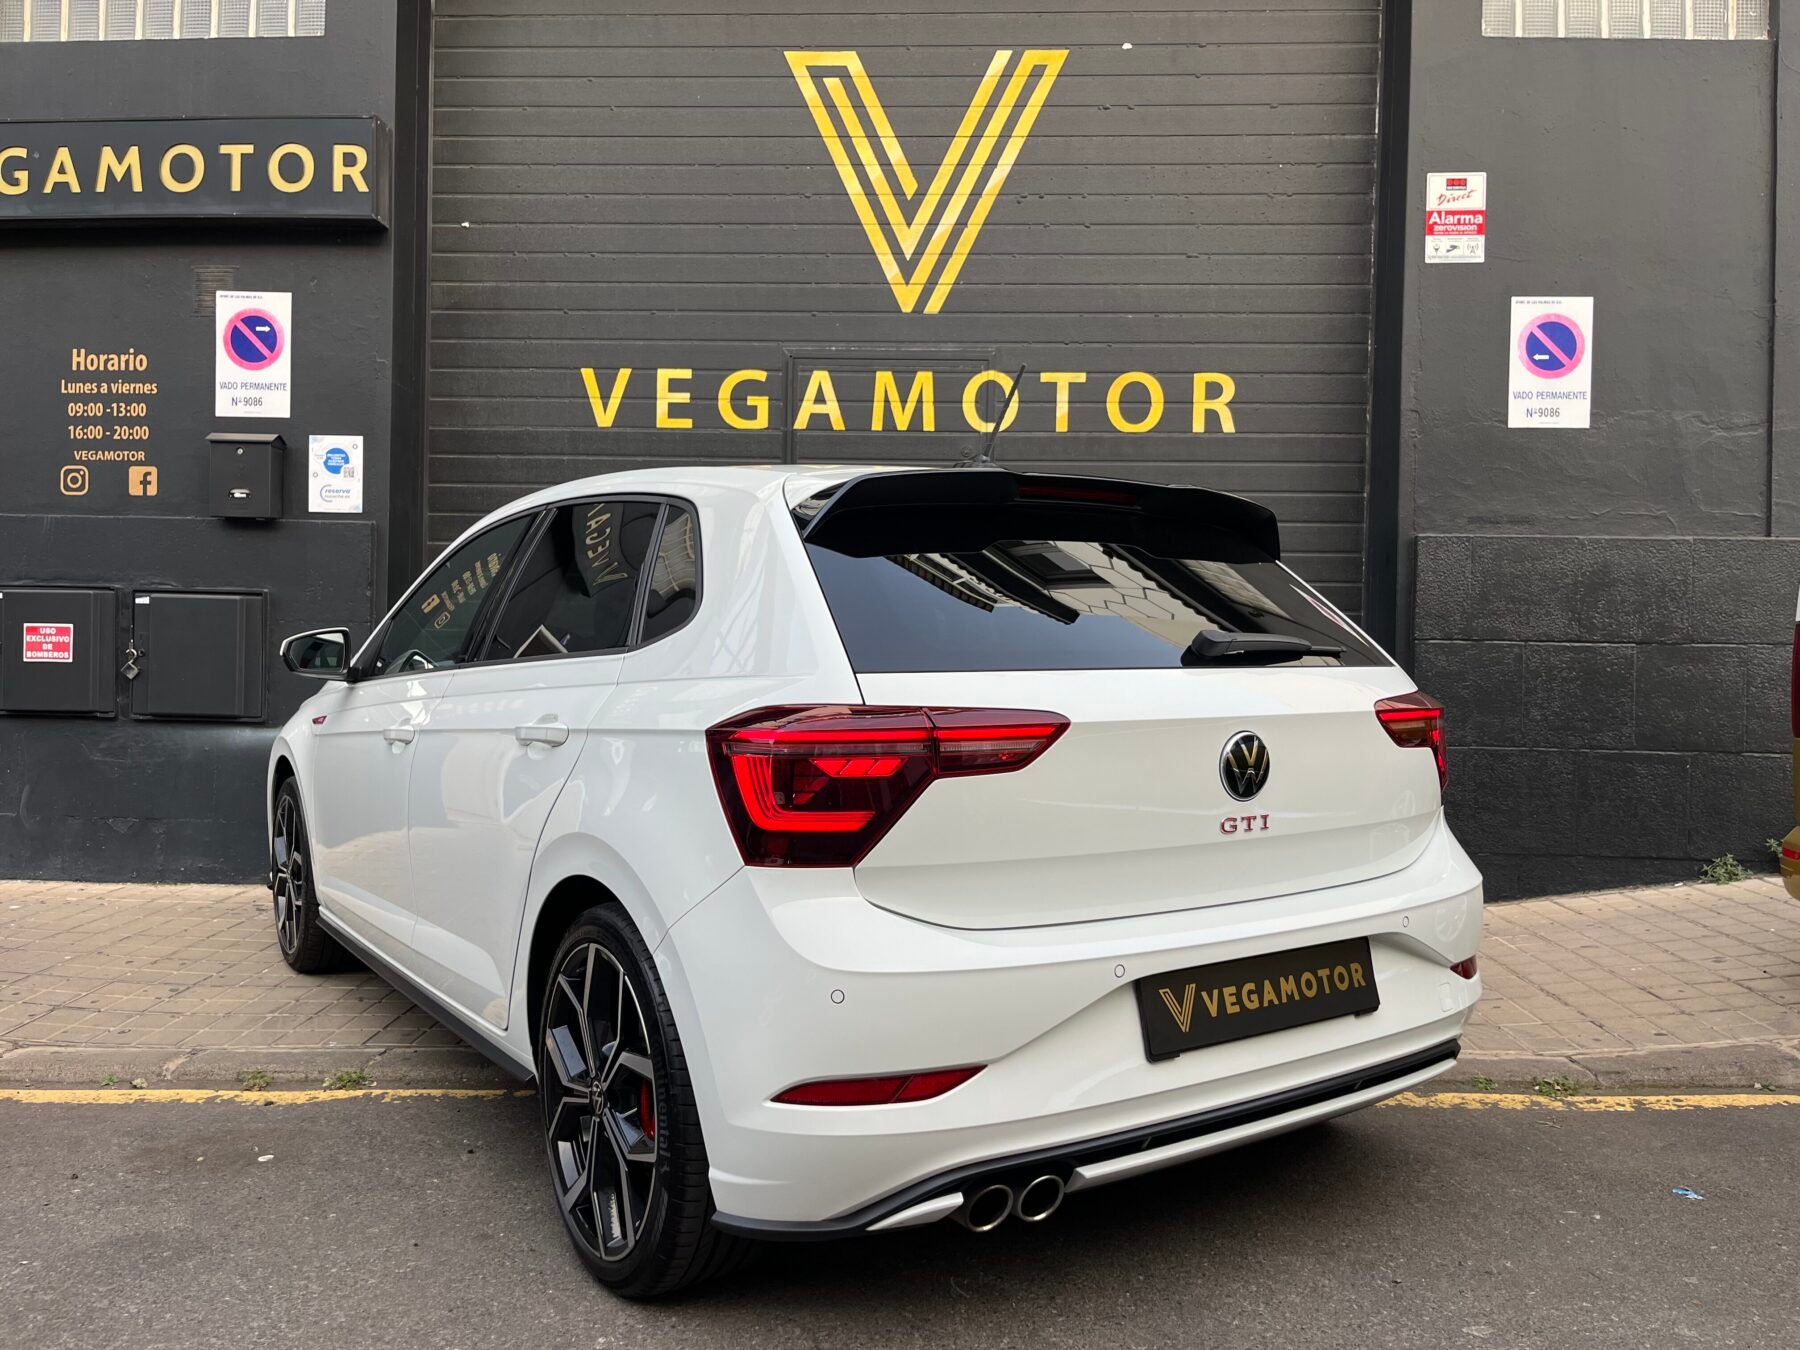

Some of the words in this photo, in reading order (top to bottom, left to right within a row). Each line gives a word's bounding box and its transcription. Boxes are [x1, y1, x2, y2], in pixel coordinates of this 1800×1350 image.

[0, 143, 370, 195] GAMOTOR
[1437, 189, 1477, 206] Direct
[1429, 211, 1484, 225] Alarma
[72, 348, 148, 371] Horario
[60, 379, 98, 394] Lunes
[100, 382, 108, 394] a
[110, 379, 158, 394] viernes
[219, 381, 238, 391] VADO
[240, 382, 288, 392] PERMANENTE
[580, 367, 1236, 434] VEGAMOTOR
[1513, 391, 1534, 400] VADO
[1536, 391, 1588, 400] PERMANENTE
[67, 402, 104, 417] 09:00
[67, 425, 103, 440] 16:00
[113, 425, 149, 440] 20:00
[74, 450, 145, 462] VEGAMOTOR
[39, 627, 57, 635] USO
[26, 635, 70, 643] EXCLUSIVO
[42, 643, 53, 651] DE
[26, 651, 69, 659] BOMBEROS
[1219, 813, 1271, 835] GTI
[1200, 962, 1367, 1018] VEGAMOTOR
